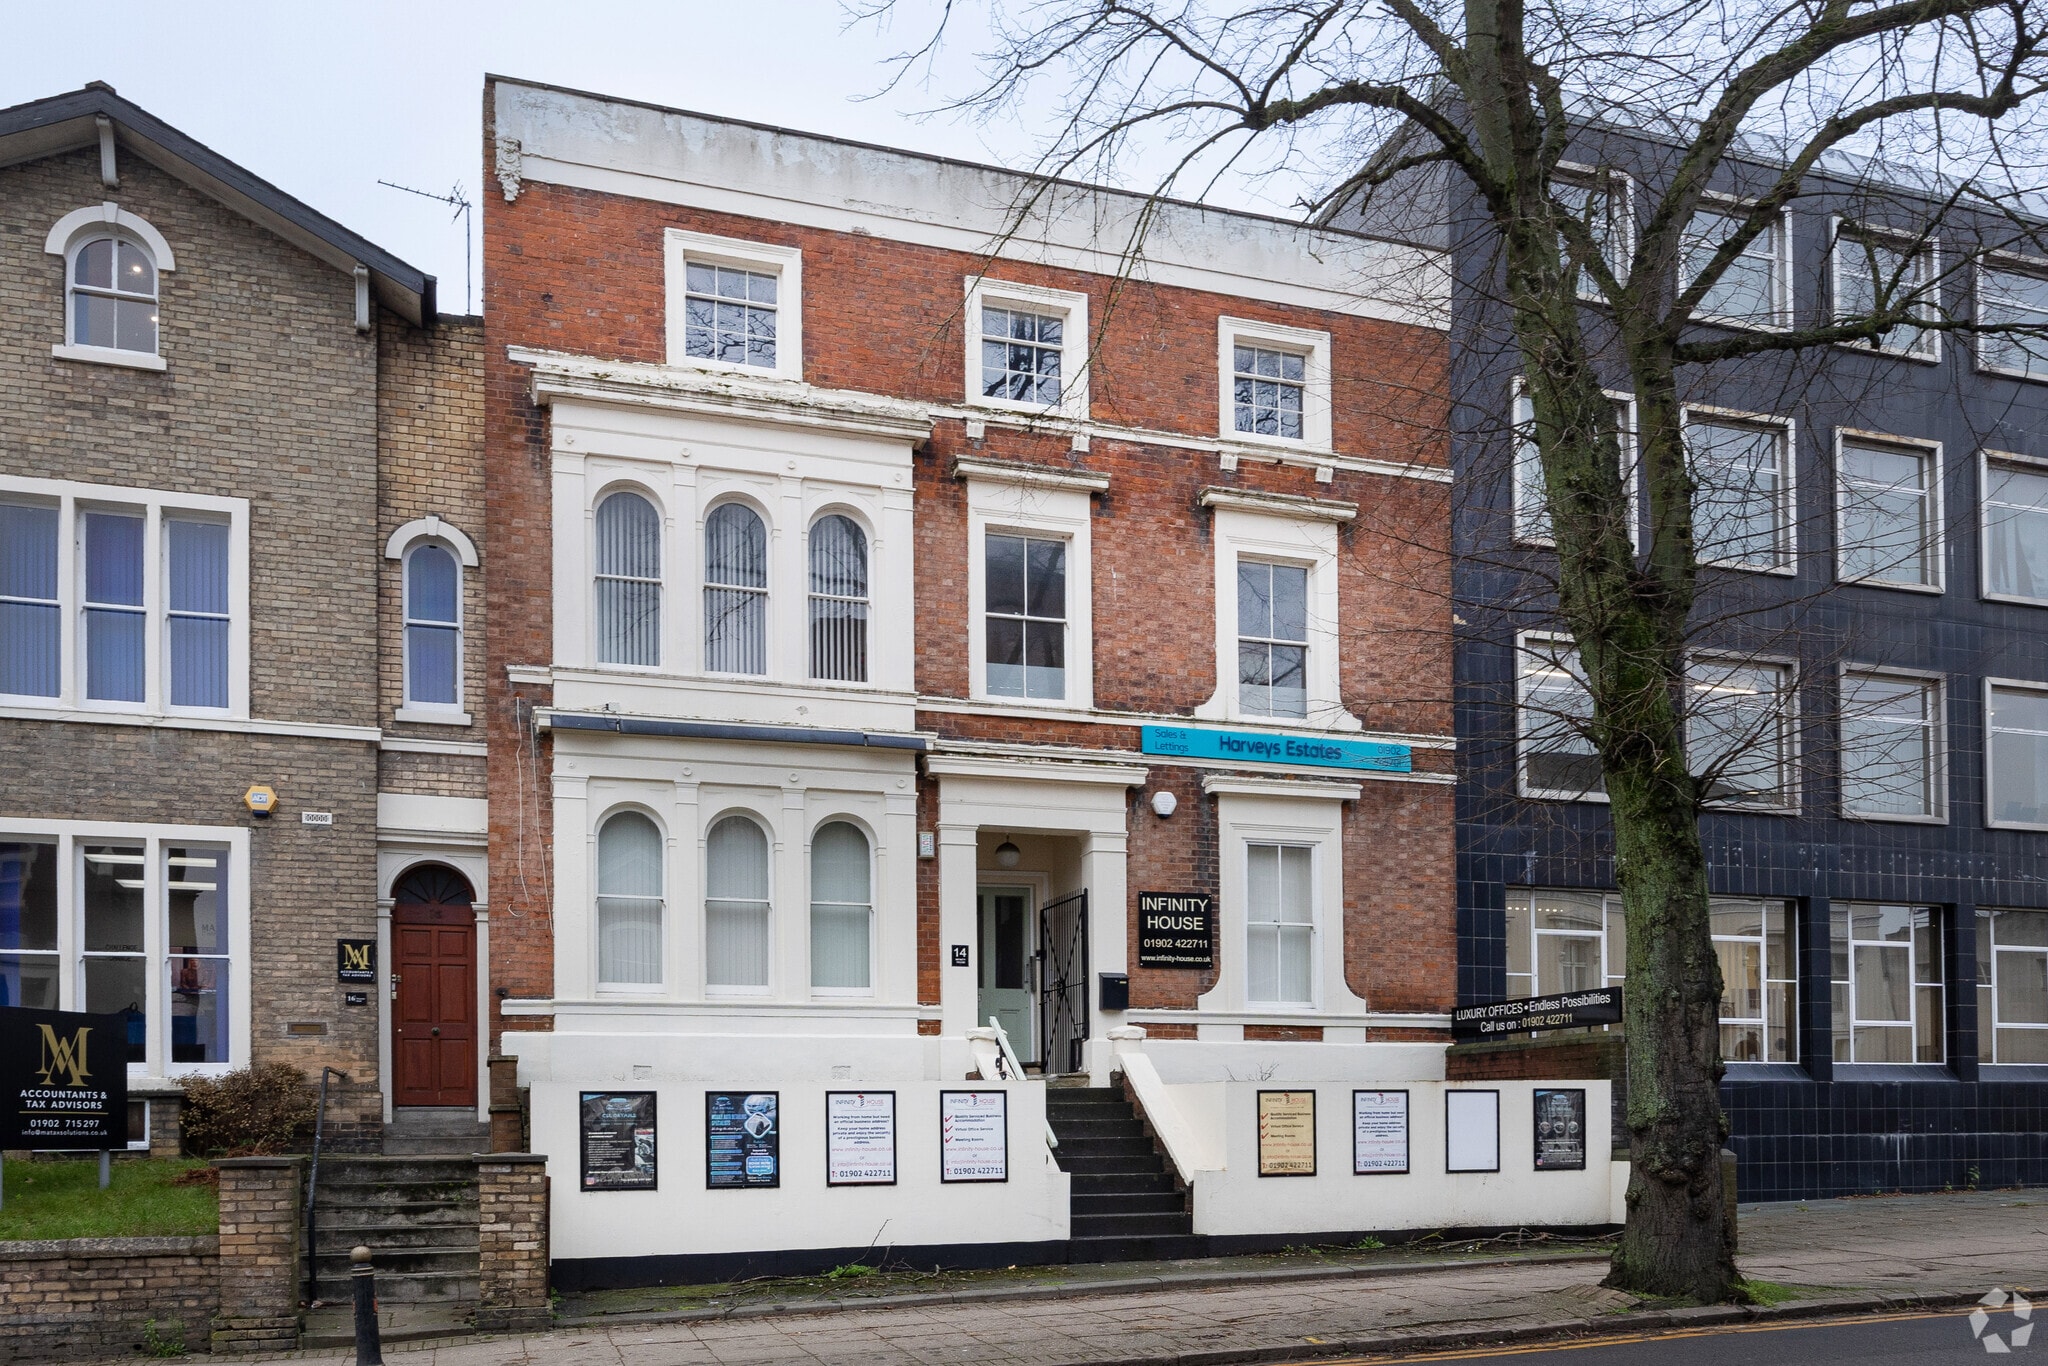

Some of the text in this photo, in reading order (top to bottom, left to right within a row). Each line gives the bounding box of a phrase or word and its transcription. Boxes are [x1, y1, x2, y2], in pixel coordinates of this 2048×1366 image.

[1155, 729, 1186, 739] Sales &
[1155, 741, 1189, 754] Lettings
[1220, 736, 1342, 760] Harveys Estates
[1378, 745, 1401, 755] 01902
[1142, 897, 1208, 912] INFINITY
[1147, 916, 1204, 930] HOUSE
[1144, 939, 1208, 948] 01902 422711
[954, 947, 966, 957] 14
[1141, 954, 1211, 963] www.infinity-house.co.uk
[1456, 992, 1611, 1020] LUXURY OFFICES Endless Possibilities
[1481, 1021, 1495, 1032] Call
[1496, 1022, 1505, 1031] us
[1506, 1021, 1516, 1030] on
[1522, 1015, 1544, 1028] 01902
[1546, 1013, 1573, 1025] 422711
[20, 1089, 107, 1099] ACCOUNTANTS &
[26, 1100, 102, 1109] TAX ADVISORS
[30, 1119, 100, 1128] 01902 715297
